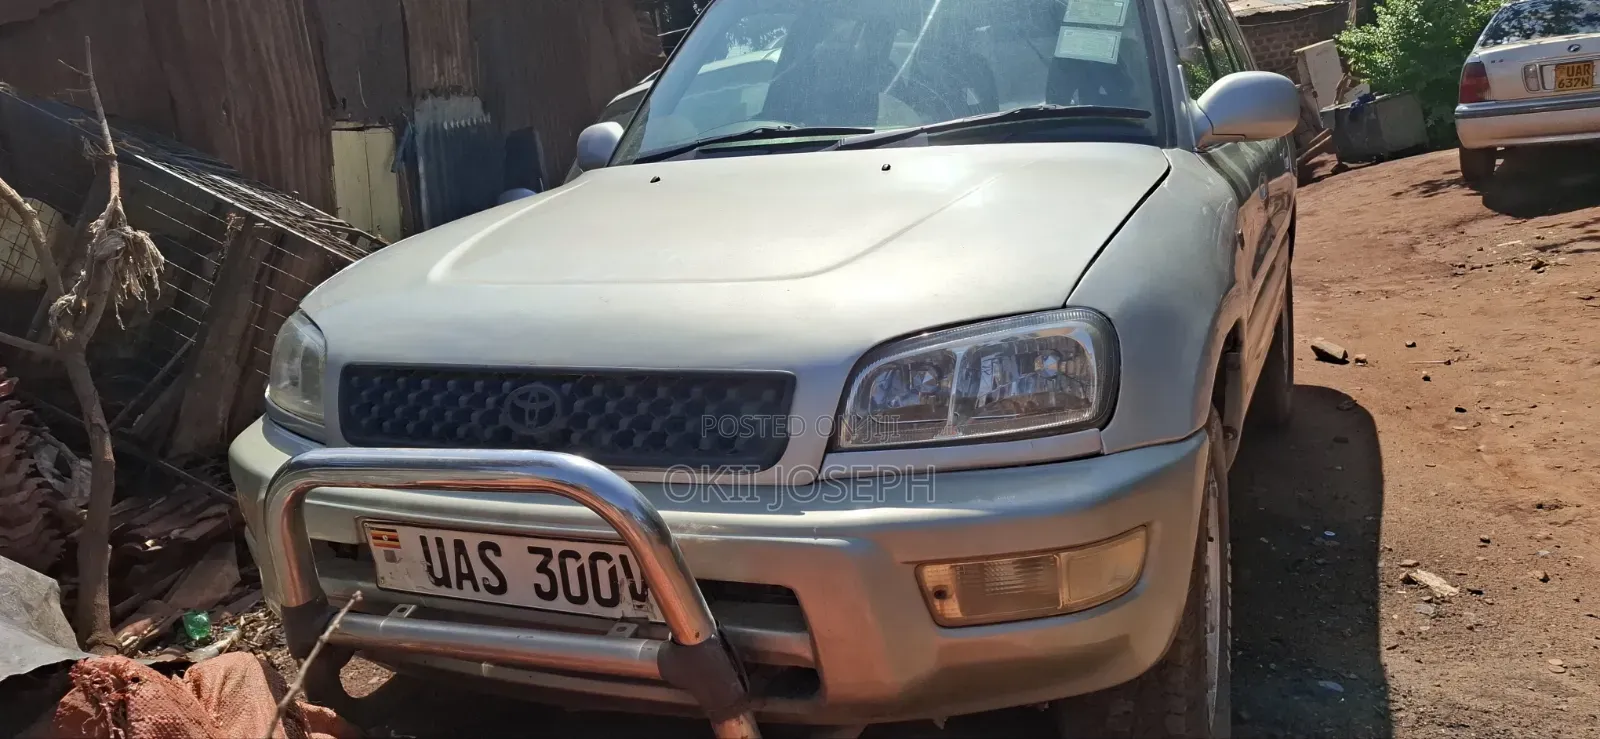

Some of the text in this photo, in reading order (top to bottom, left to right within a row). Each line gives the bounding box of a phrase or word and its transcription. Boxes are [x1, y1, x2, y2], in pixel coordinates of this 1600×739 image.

[1566, 63, 1591, 77] UAR
[1557, 76, 1589, 88] 637N
[419, 535, 508, 596] UAS
